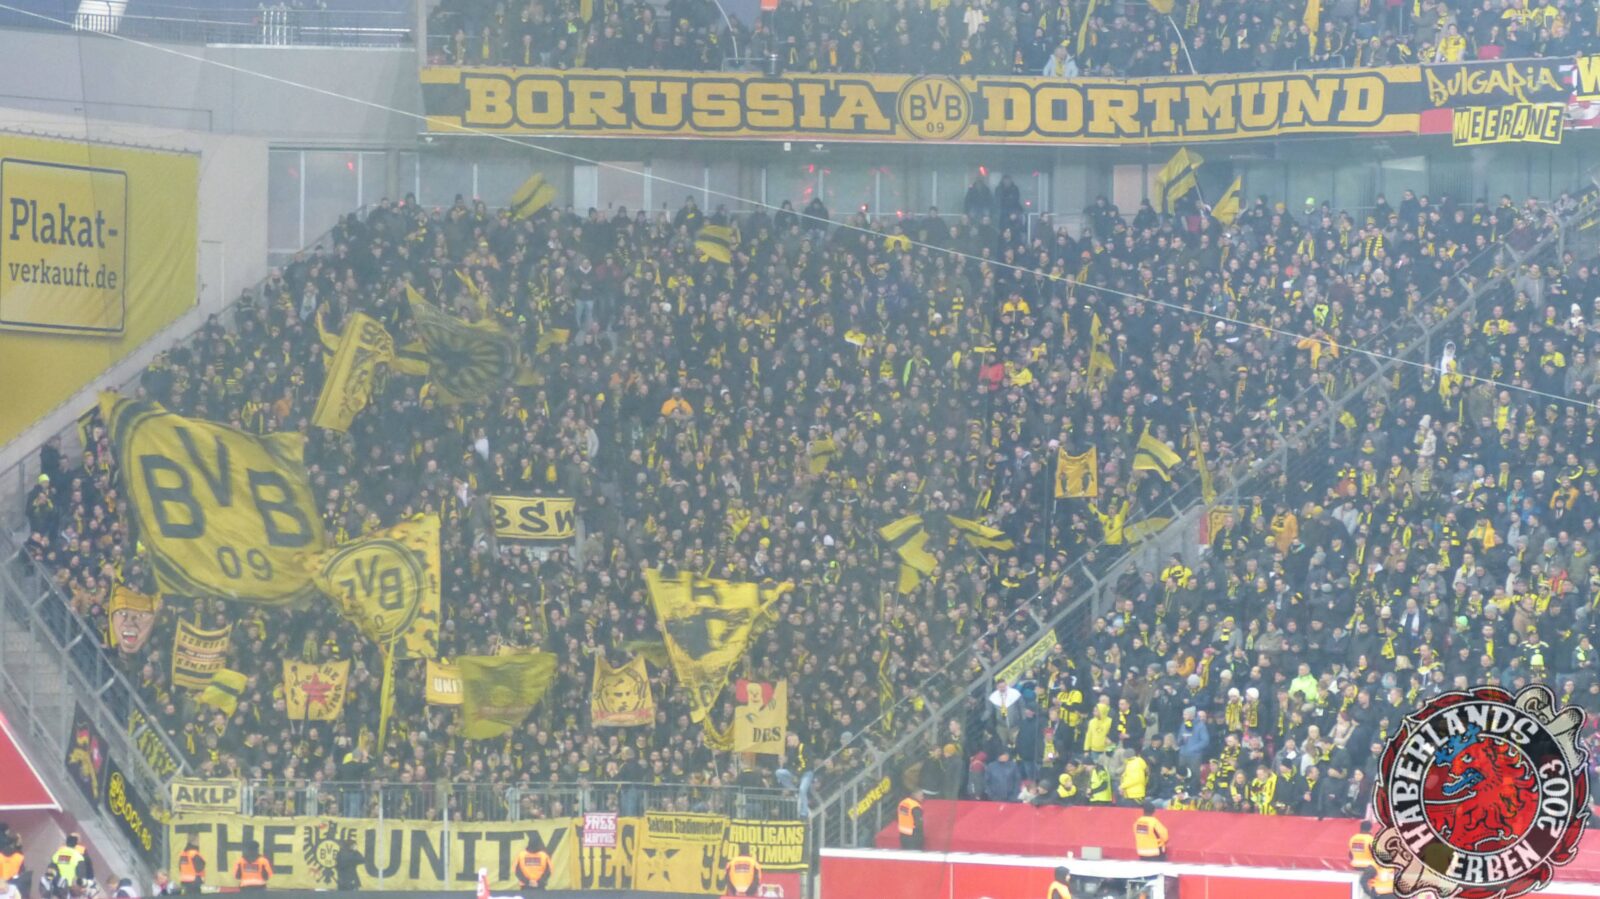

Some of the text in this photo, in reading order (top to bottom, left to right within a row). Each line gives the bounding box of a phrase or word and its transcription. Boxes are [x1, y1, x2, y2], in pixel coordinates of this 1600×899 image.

[465, 71, 1374, 136] BORUSSIA DORTMUND
[910, 83, 963, 121] BVB
[926, 121, 945, 133] 09
[1453, 105, 1565, 144] MEERANE
[9, 197, 119, 248] Plakat-
[8, 258, 118, 289] verkauft.de
[138, 425, 315, 548] BVB
[216, 545, 273, 582] 09
[175, 786, 238, 804] AKLP
[727, 841, 803, 864] DRTMUND
[730, 824, 804, 846] HOOLIGANS
[364, 826, 568, 884] UNITY
